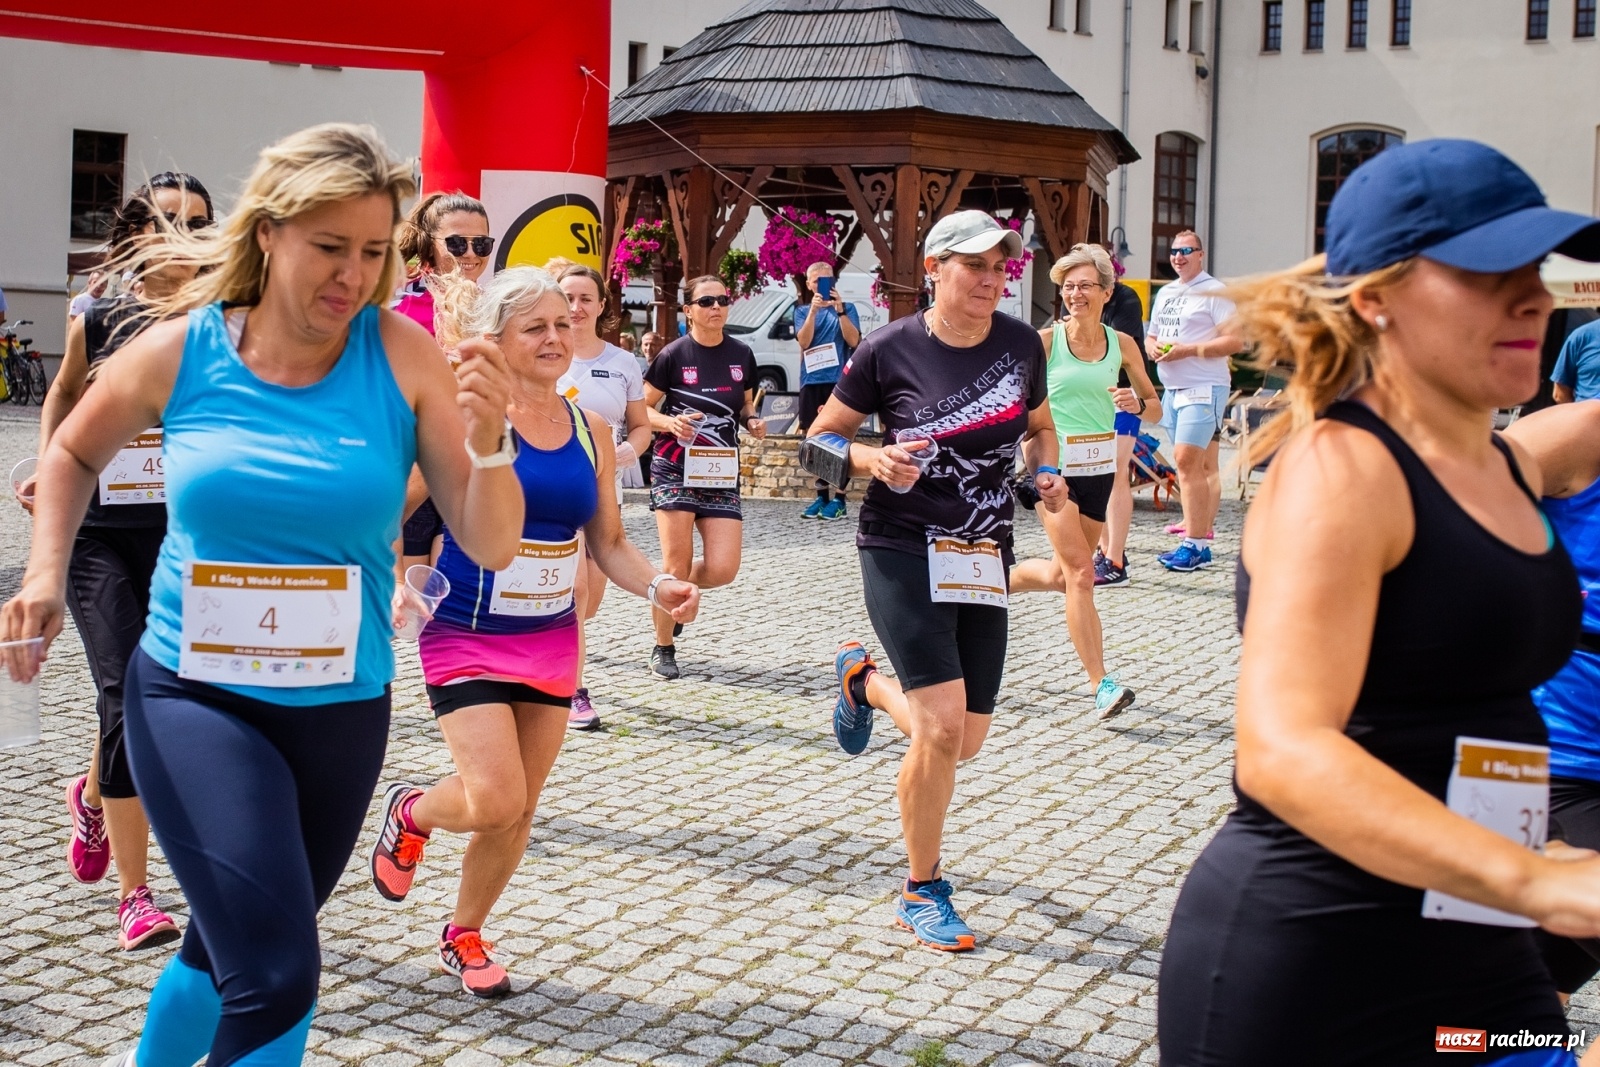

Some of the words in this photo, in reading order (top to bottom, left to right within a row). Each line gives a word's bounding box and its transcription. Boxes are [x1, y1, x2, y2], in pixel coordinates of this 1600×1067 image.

[913, 406, 935, 423] KS
[937, 386, 971, 413] GRYF
[973, 352, 1016, 392] KIETRZ
[1086, 447, 1100, 459] 19
[707, 462, 722, 473] 25
[524, 547, 540, 557] Bieg
[537, 567, 560, 587] 35
[972, 561, 982, 578] 5
[219, 573, 245, 587] Bieg
[246, 575, 282, 587] Wokół
[284, 575, 329, 587] Komina
[258, 606, 280, 636] 4
